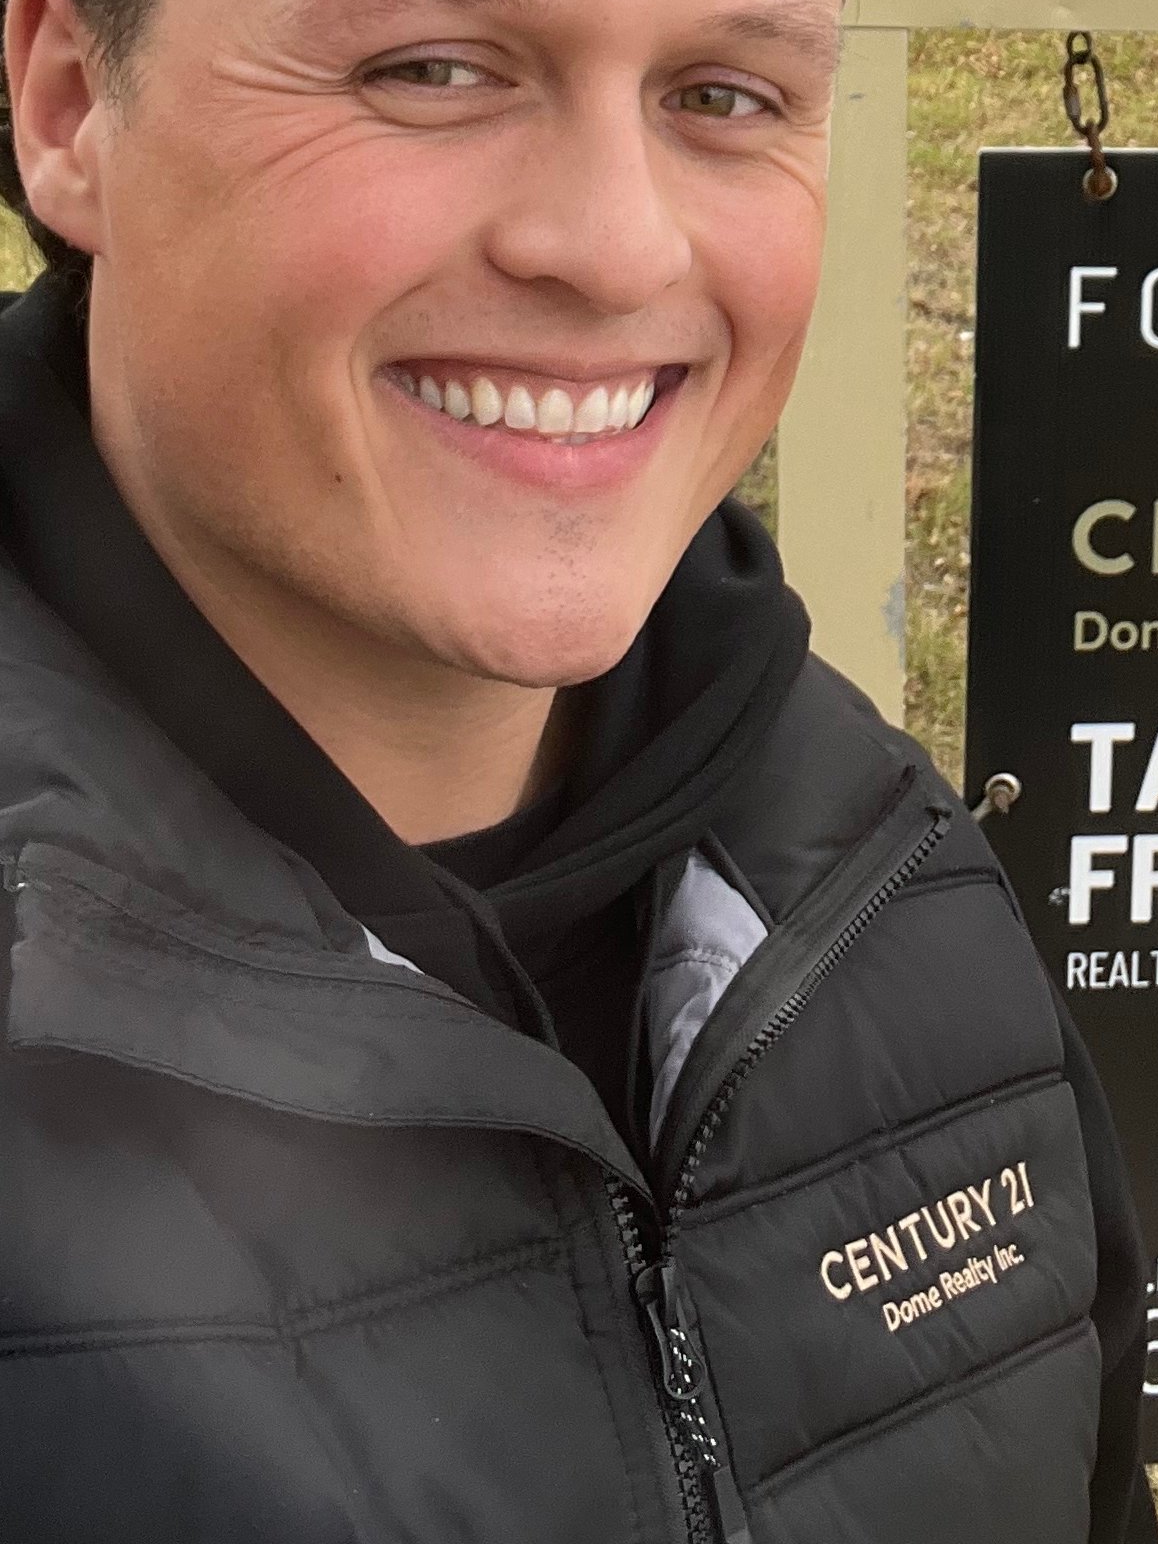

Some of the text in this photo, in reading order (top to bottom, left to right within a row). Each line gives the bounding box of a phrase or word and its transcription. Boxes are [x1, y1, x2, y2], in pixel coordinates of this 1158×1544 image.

[820, 1160, 1035, 1301] CENTURY 21
[882, 1243, 1026, 1333] Dome Realty Inc.
